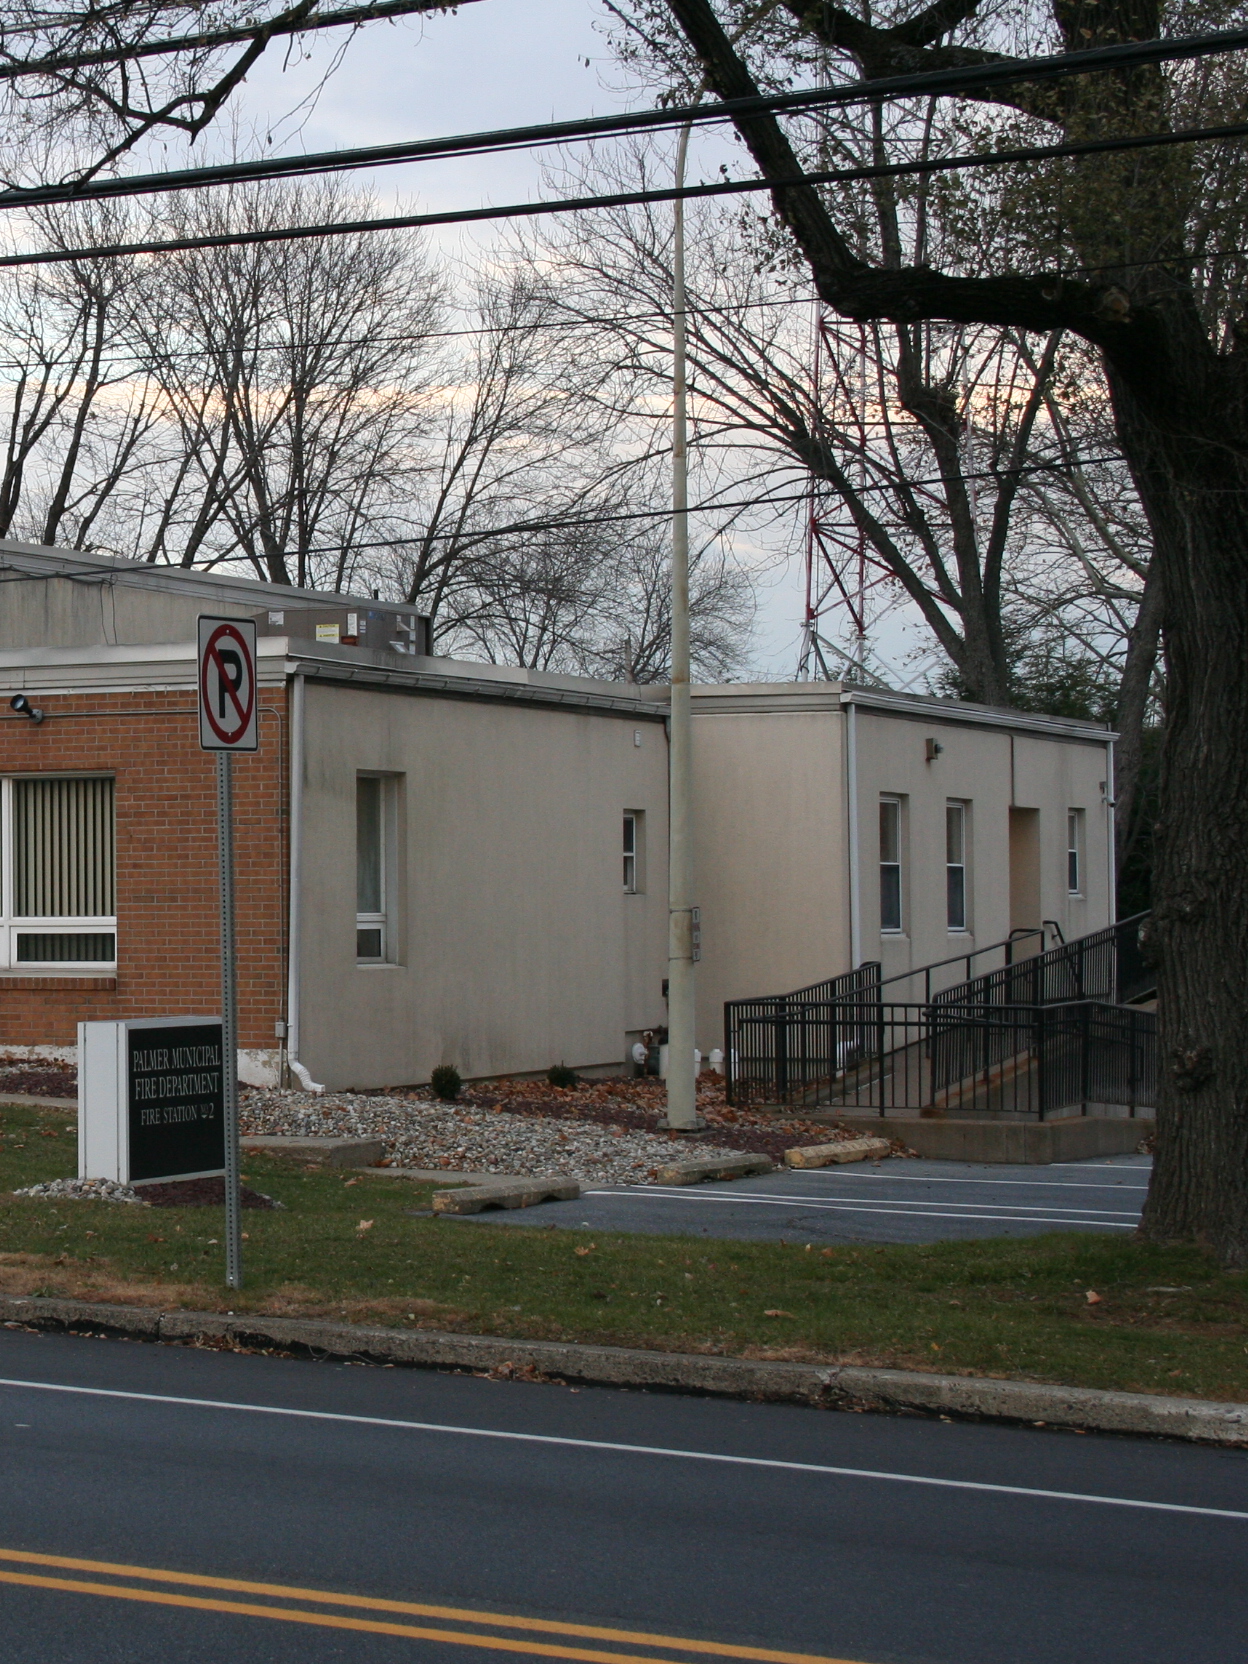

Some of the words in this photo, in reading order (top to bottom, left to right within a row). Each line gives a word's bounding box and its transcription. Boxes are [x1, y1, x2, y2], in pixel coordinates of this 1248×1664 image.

[133, 1048, 170, 1072] PALMER
[172, 1044, 221, 1069] MUNICIPAL
[135, 1077, 157, 1100] FIRE
[159, 1072, 219, 1098] DEPARTMENT
[141, 1107, 161, 1126] FIRE
[163, 1104, 198, 1124] STATION
[209, 1102, 214, 1119] 2
